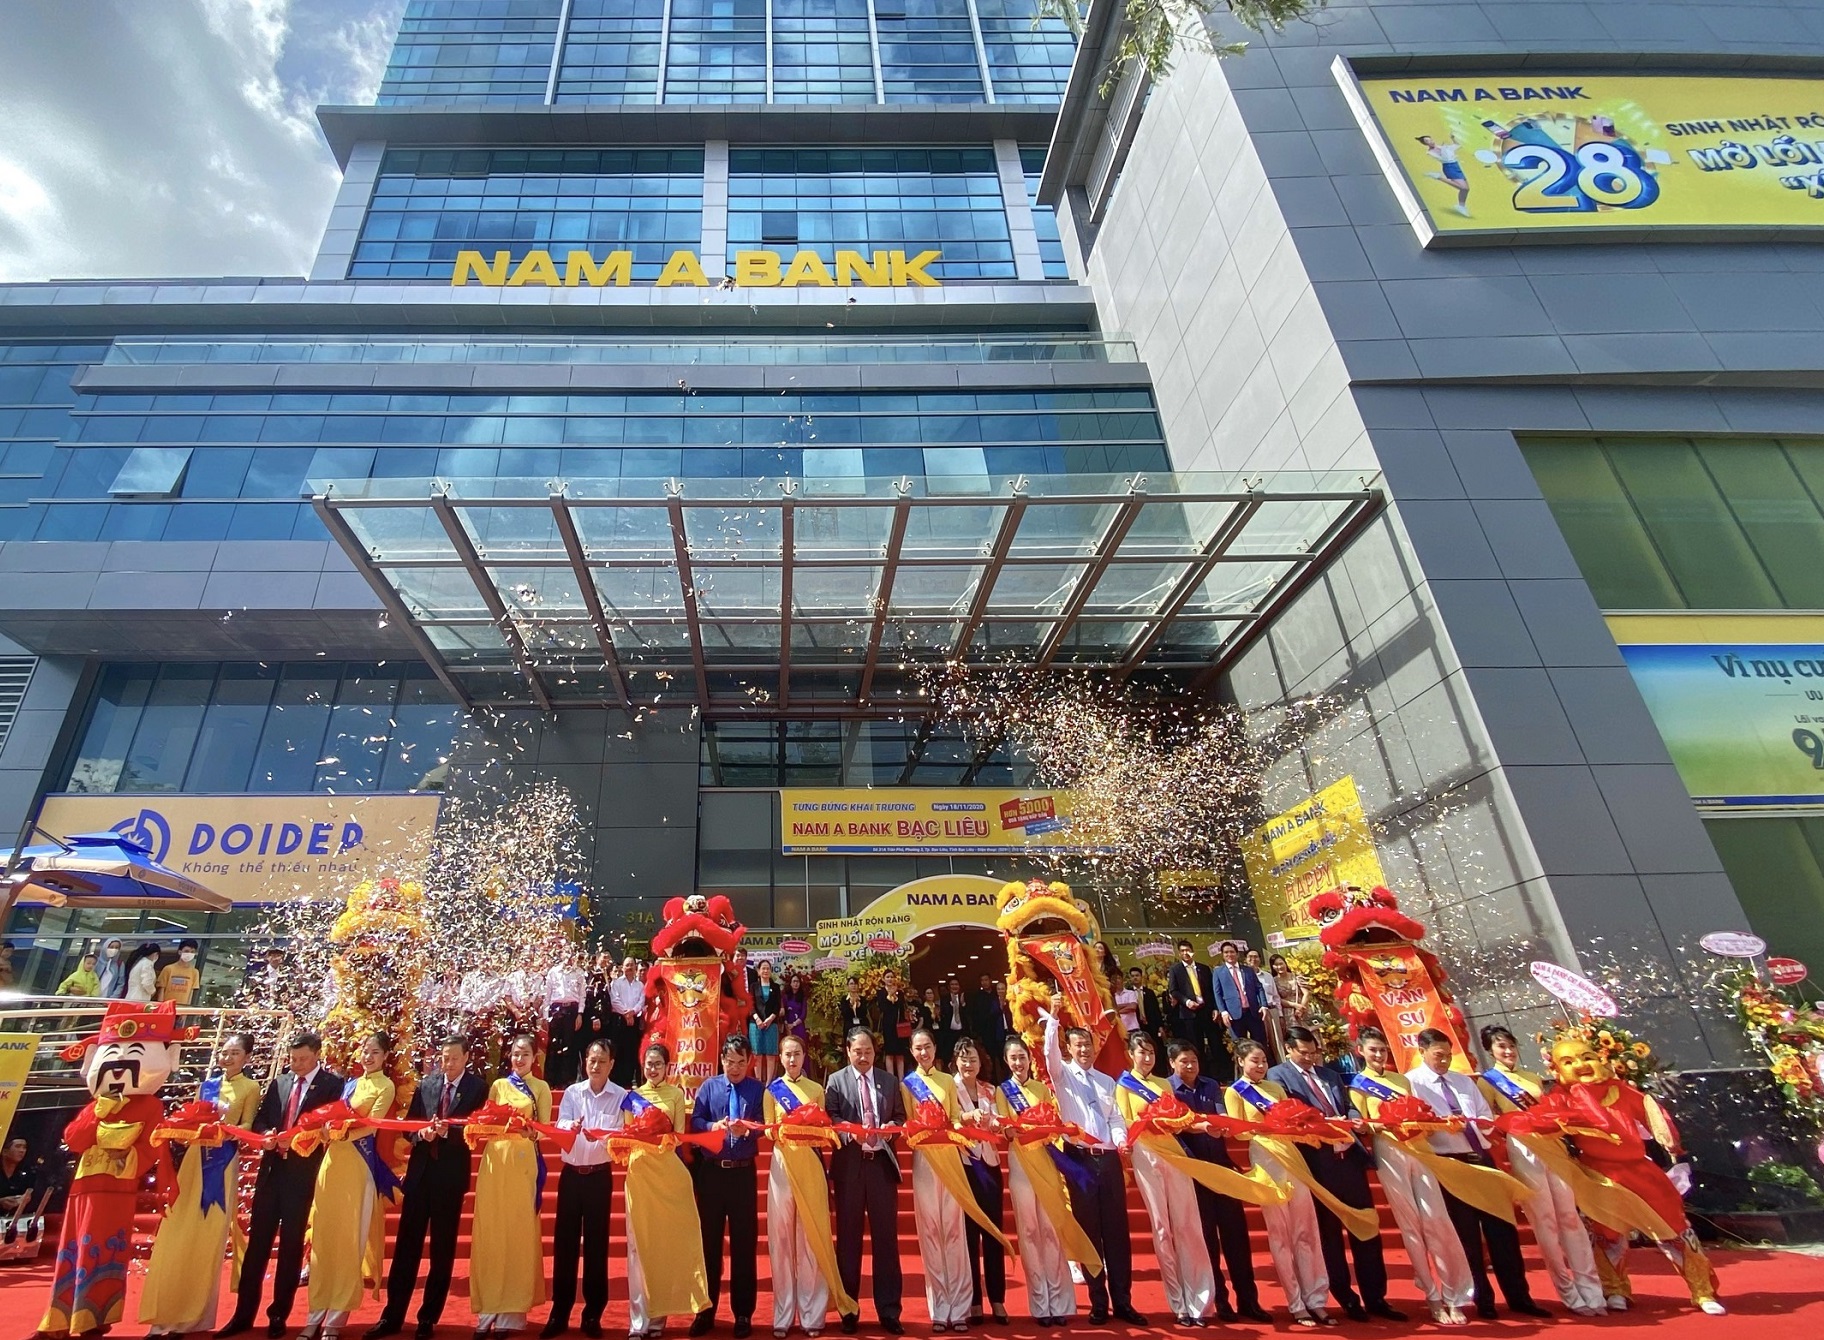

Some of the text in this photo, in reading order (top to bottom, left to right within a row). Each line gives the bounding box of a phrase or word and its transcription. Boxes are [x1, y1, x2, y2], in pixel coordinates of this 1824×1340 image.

[1388, 86, 1592, 104] NAM A BANK
[1665, 120, 1726, 136] SINH
[1727, 113, 1791, 134] NHẬT
[1686, 134, 1823, 172] MỞ LỐI
[1501, 141, 1661, 214] 28
[453, 250, 944, 288] NAM A BANK
[1710, 652, 1751, 678] Vì
[1749, 659, 1794, 685] nụ
[850, 803, 873, 812] KHAI
[792, 817, 988, 840] NAM A BANK BẠC LIÊU
[1261, 823, 1287, 845] NAM
[182, 861, 230, 875] Không
[1284, 861, 1335, 907] HAPPY
[908, 893, 999, 906] NAM A BAN
[626, 911, 654, 924] 31A
[818, 921, 839, 931] SINH
[866, 916, 886, 927] RỘN
[1280, 902, 1312, 929] TRA
[765, 936, 775, 946] A
[820, 933, 841, 948] MỞ
[844, 930, 864, 946] LỐI
[1114, 938, 1143, 946] NAM
